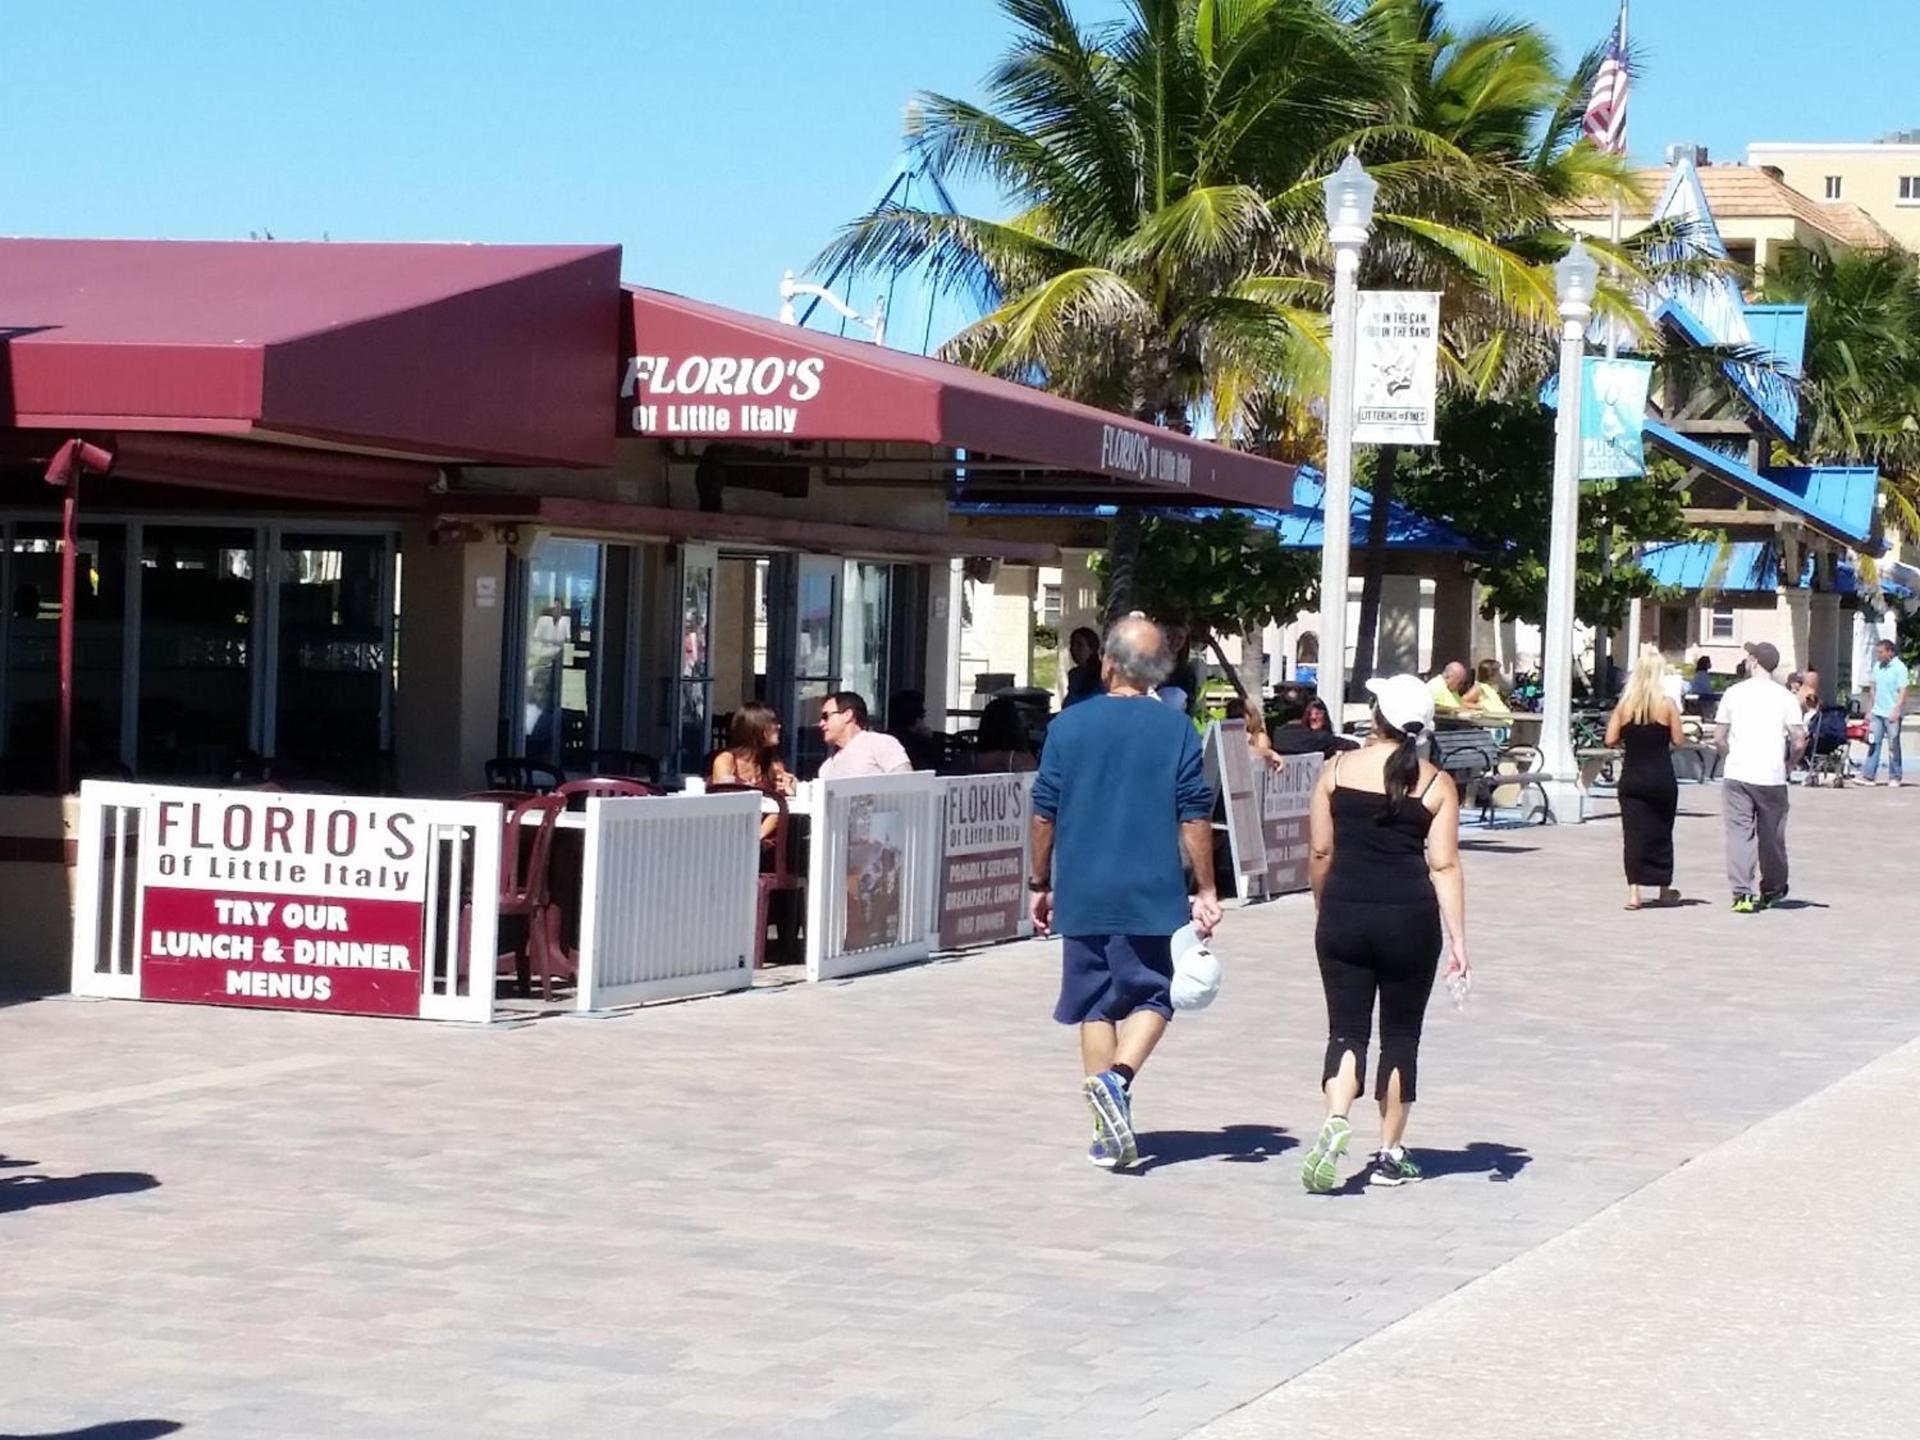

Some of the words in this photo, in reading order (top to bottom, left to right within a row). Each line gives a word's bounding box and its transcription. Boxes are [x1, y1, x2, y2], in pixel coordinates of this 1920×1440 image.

[1393, 326, 1406, 338] THE
[1394, 312, 1408, 324] THE
[621, 356, 824, 401] FLORIO'S
[667, 405, 731, 432] Little
[741, 405, 798, 434] Italy
[1101, 425, 1149, 480] FLORIO'S
[950, 783, 1022, 824] FLORIO'S
[158, 800, 415, 861] FLORIO'S
[965, 827, 992, 847] Little
[996, 824, 1020, 842] Italy
[159, 854, 193, 877] Of
[209, 856, 306, 884] Little
[324, 863, 410, 892] Italy
[950, 862, 986, 883] PROUDLY
[987, 858, 1019, 878] SERVING
[214, 899, 276, 928] TRY
[282, 902, 349, 932] OUR
[150, 930, 255, 961] LUNCH
[261, 937, 286, 963] &
[293, 939, 412, 970] DINNER
[226, 970, 332, 1002] MENUS
